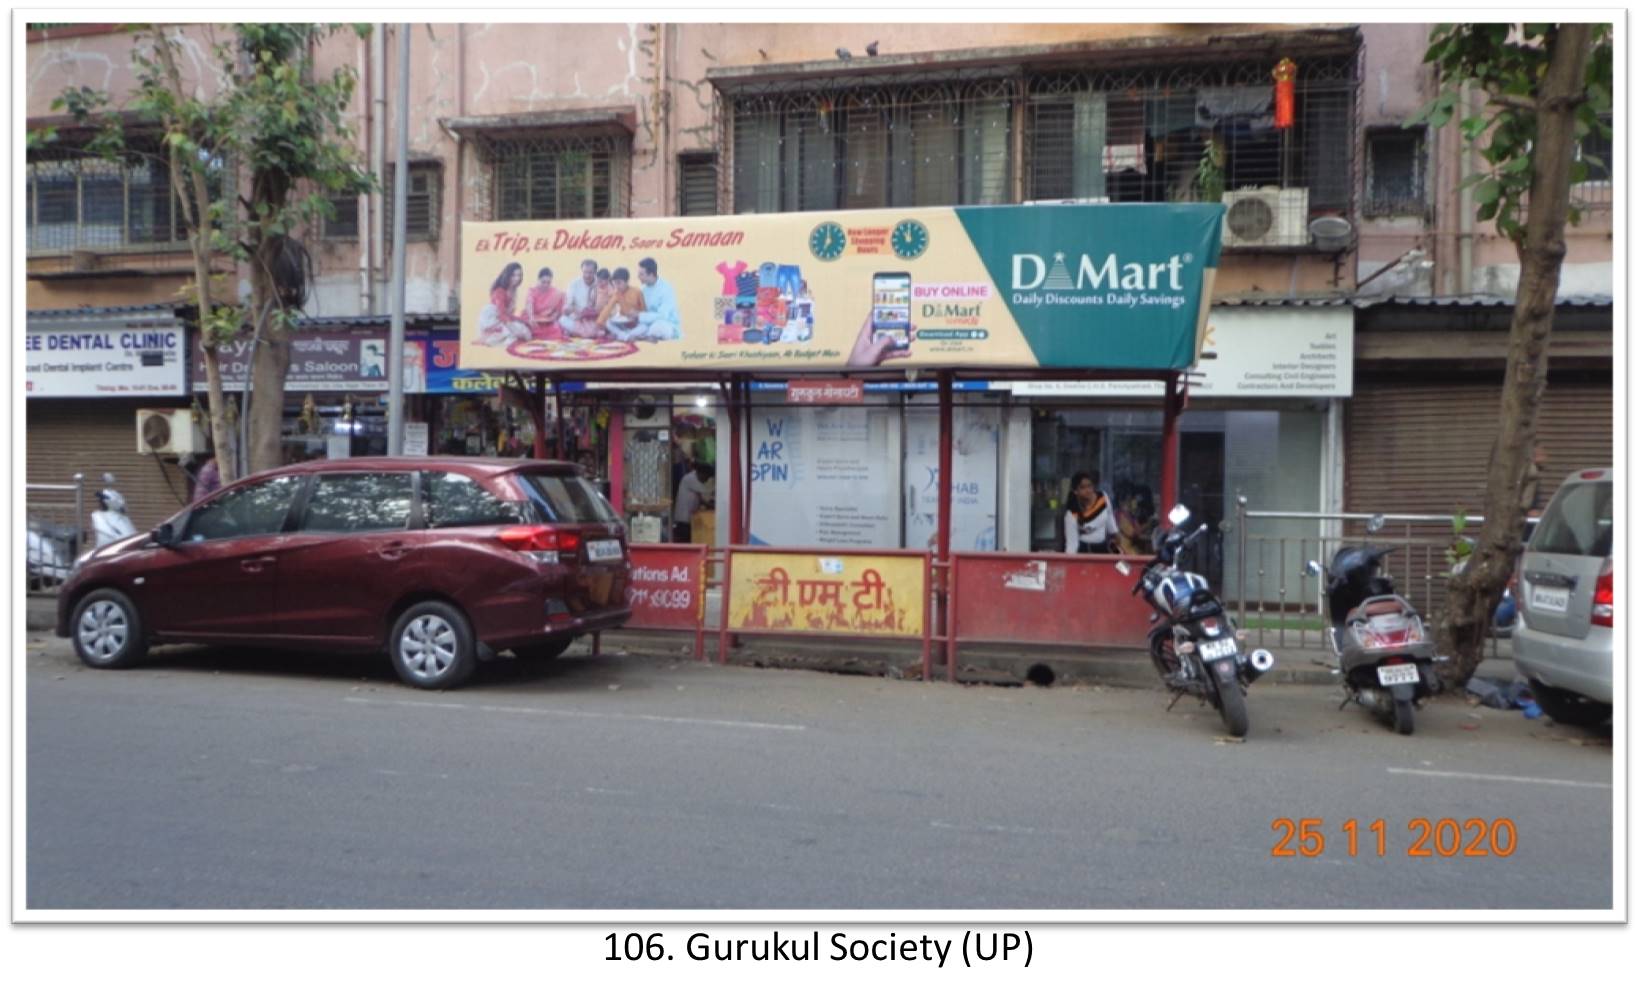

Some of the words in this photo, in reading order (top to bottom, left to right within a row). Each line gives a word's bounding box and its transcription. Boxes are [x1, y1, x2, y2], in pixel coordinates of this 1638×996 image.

[493, 231, 530, 255] Trip,
[552, 229, 626, 251] Dukaan,
[666, 228, 744, 249] Samaan
[914, 286, 938, 297] BUY
[942, 286, 988, 297] ONLINE
[1013, 293, 1043, 308] Daily
[1045, 293, 1103, 305] Discounts
[1107, 293, 1138, 308] Daily
[1140, 293, 1185, 308] Savings
[48, 334, 114, 350] DENTAL
[120, 332, 176, 349] CLINIC
[43, 363, 69, 373] Dental
[304, 360, 358, 373] Saloon
[755, 567, 791, 607] टी
[850, 568, 886, 610] टी
